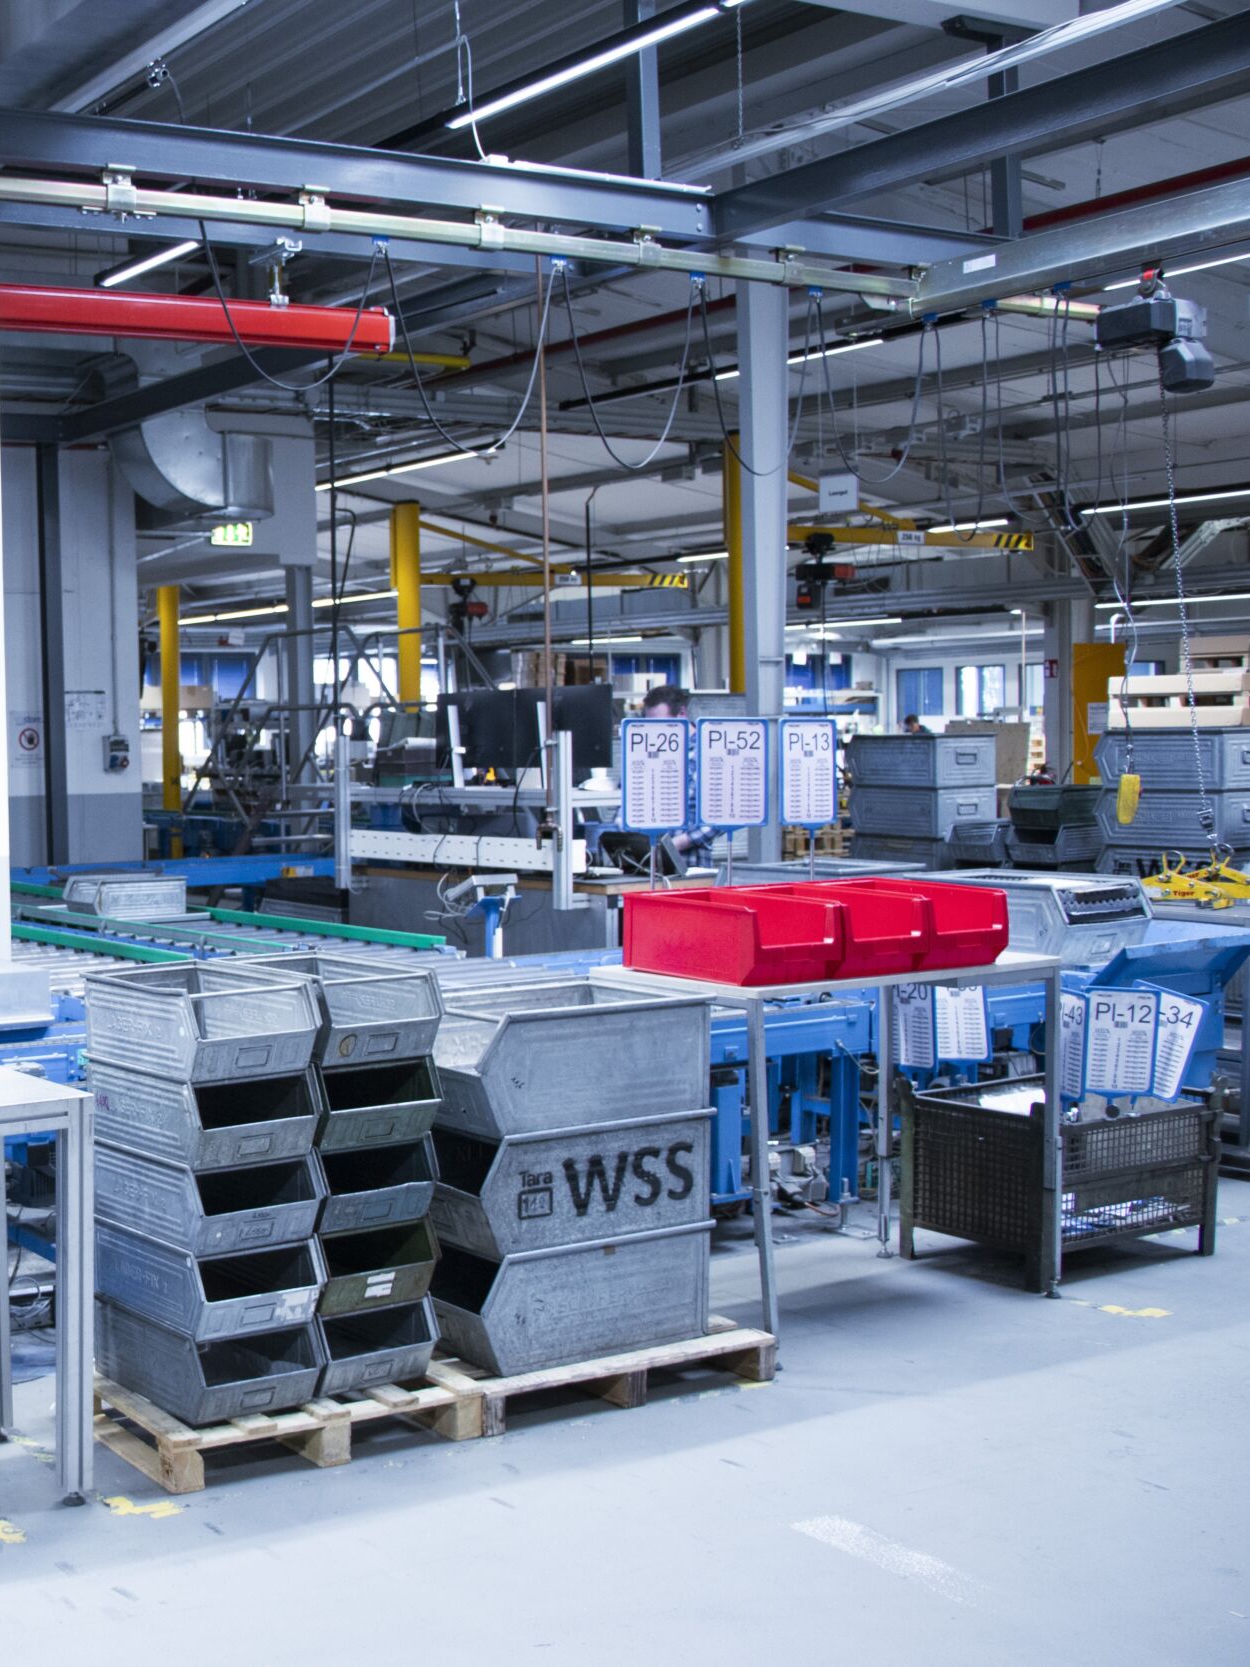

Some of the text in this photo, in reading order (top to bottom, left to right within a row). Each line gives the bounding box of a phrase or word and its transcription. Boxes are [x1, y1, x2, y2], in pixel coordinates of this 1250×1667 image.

[1173, 890, 1195, 898] Tiger
[519, 1170, 553, 1187] Tara
[562, 1141, 694, 1217] WSS
